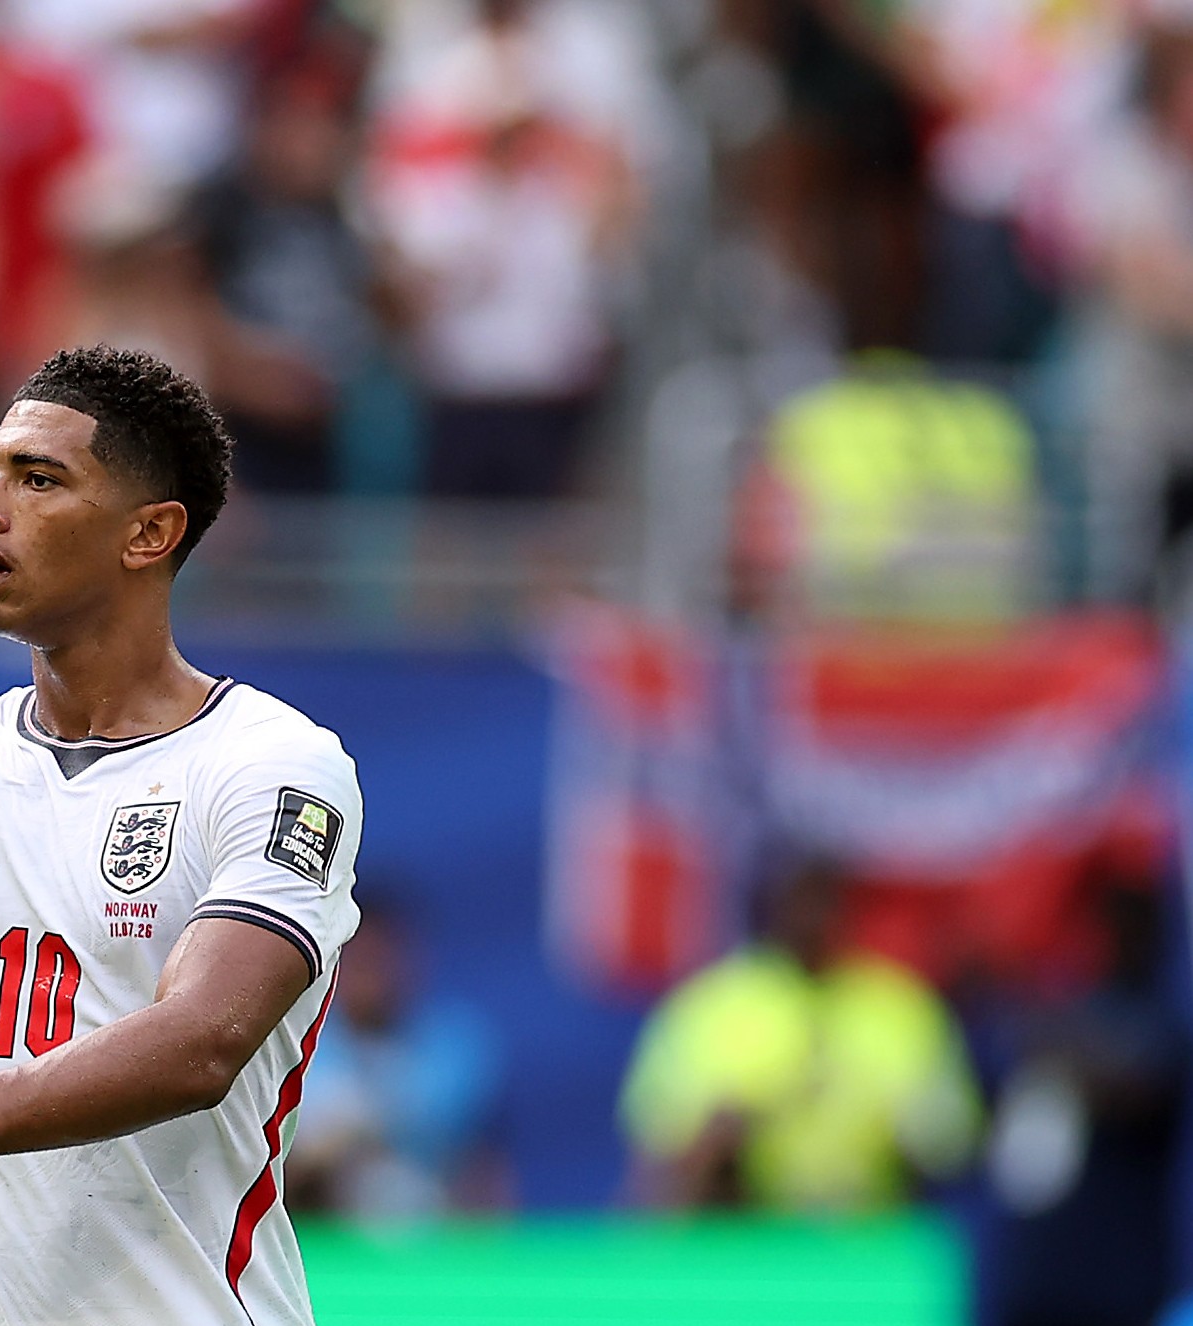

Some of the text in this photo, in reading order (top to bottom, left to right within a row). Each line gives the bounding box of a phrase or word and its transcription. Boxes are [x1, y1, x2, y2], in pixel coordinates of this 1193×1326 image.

[281, 835, 324, 872] EDUCATION
[293, 855, 310, 871] FIFA
[105, 902, 158, 918] NORWAY
[110, 922, 153, 938] 11.07.26
